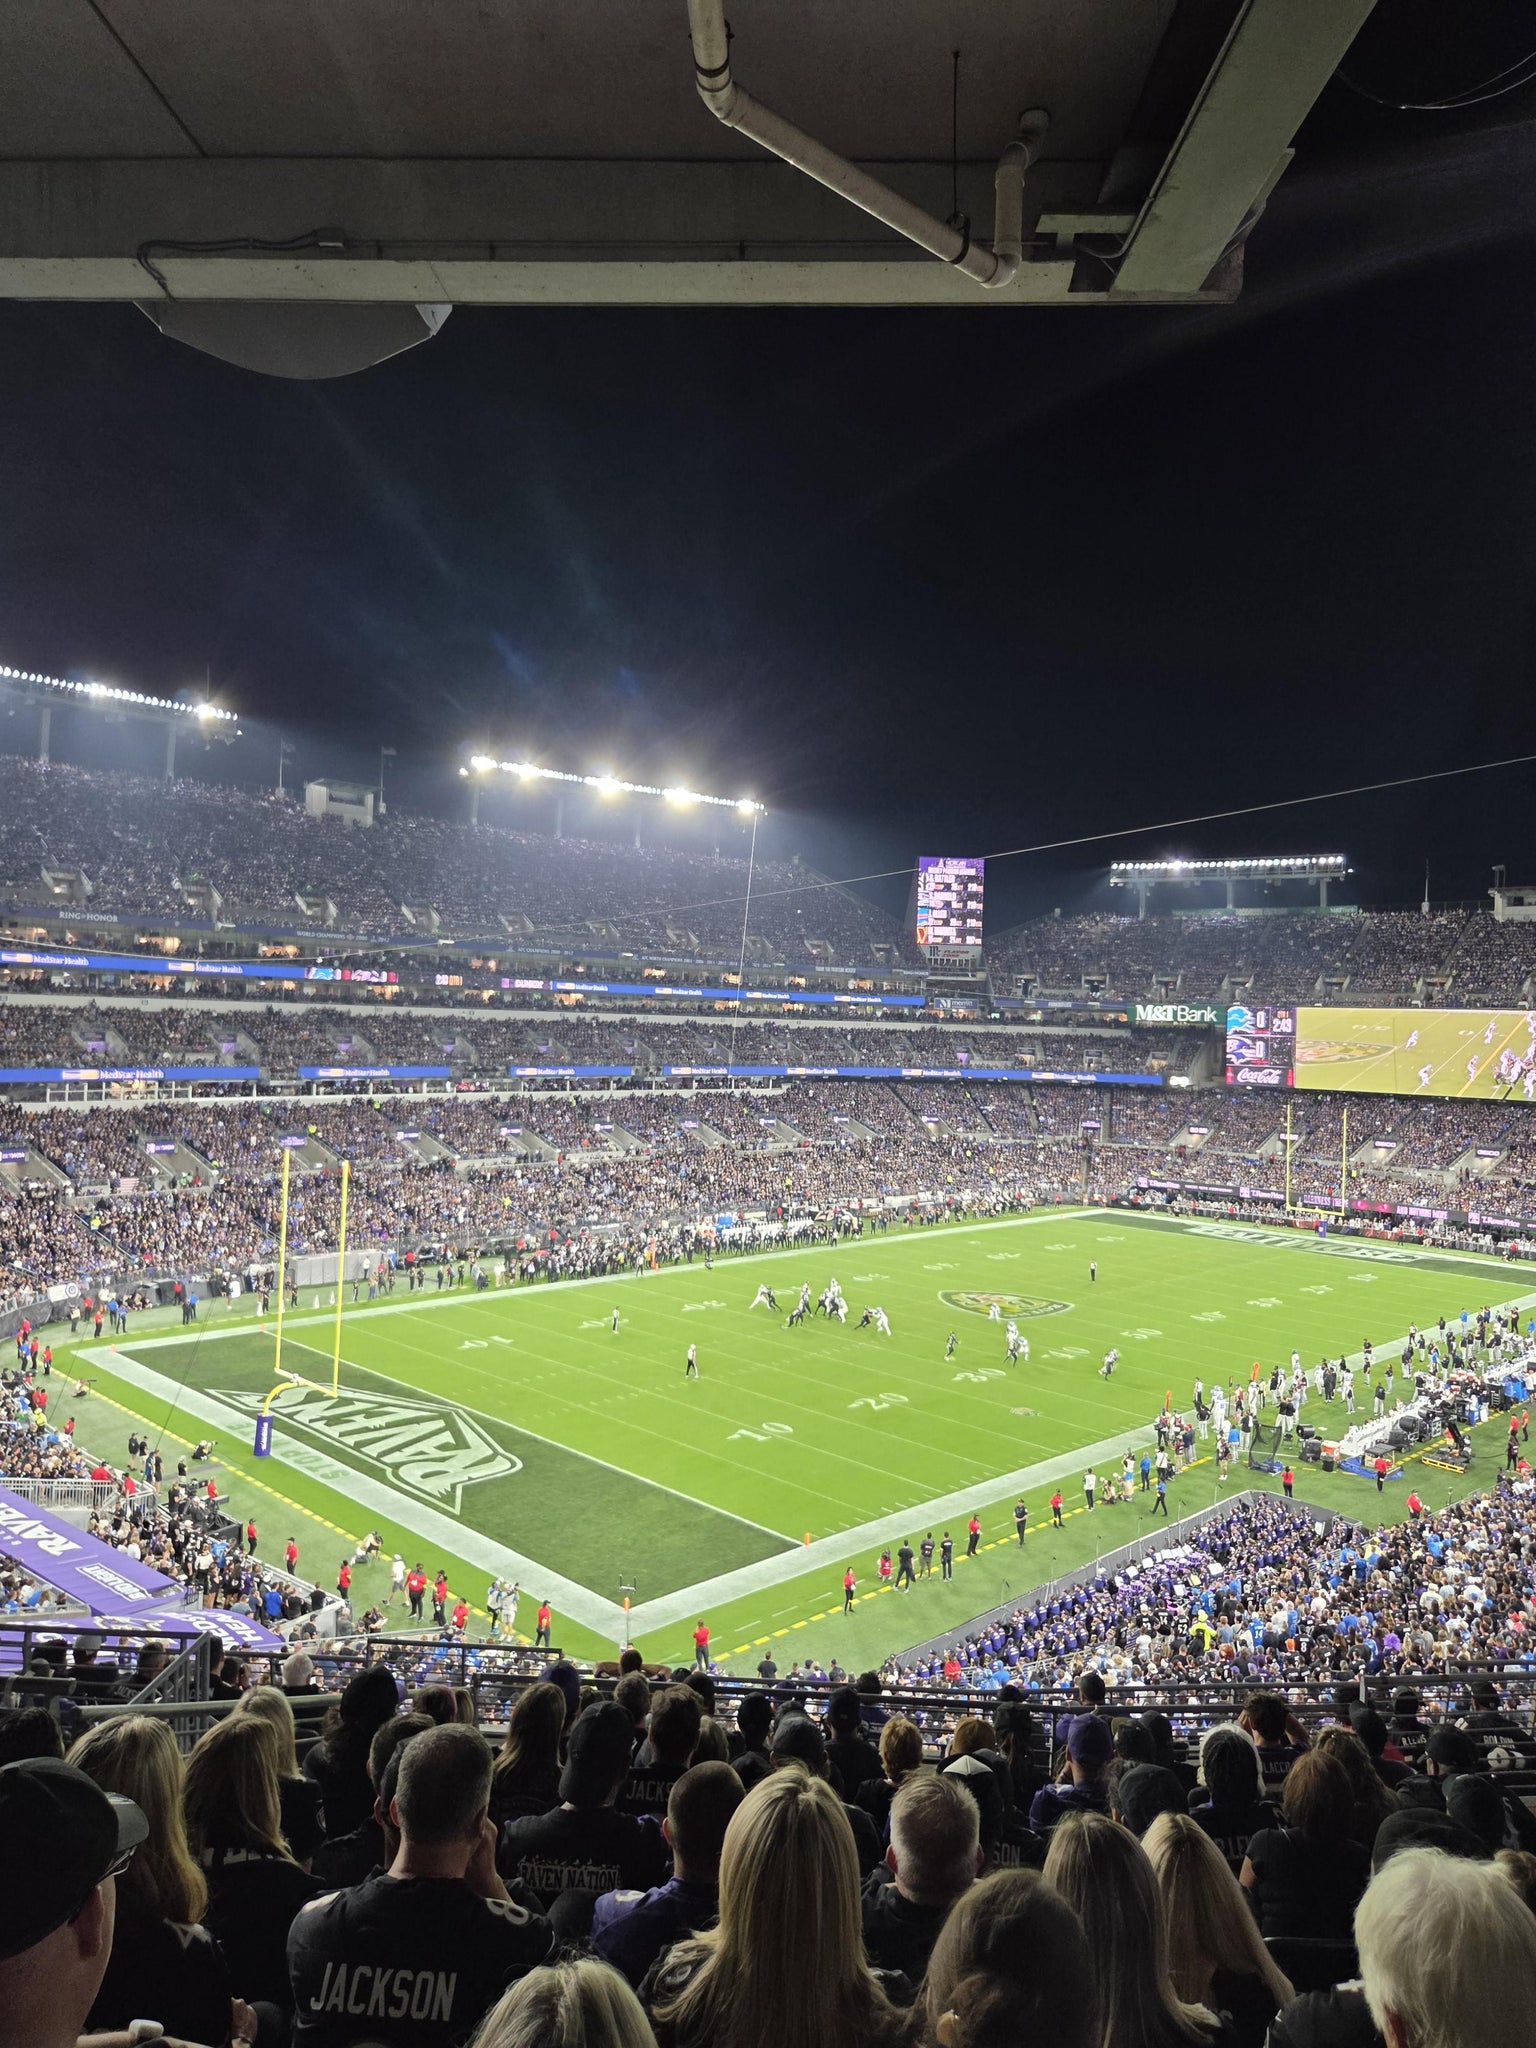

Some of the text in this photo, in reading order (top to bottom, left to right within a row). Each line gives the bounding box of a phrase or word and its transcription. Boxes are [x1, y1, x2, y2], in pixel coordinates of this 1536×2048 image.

[59, 911, 80, 920] RING
[87, 913, 118, 922] HONOR
[33, 956, 89, 966] MedStar Health
[196, 962, 244, 974] MedStar Health
[1136, 1004, 1218, 1022] M&T Bank
[1256, 1011, 1265, 1029] 0
[1273, 1018, 1292, 1033] 2:43
[1256, 1041, 1264, 1058] 0
[100, 1069, 165, 1079] MedStar Health
[711, 1067, 728, 1075] Health
[727, 1421, 794, 1442] 10
[239, 1385, 512, 1498] RAVENS
[520, 1864, 618, 1890] RAVEN NATION
[310, 1961, 457, 2022] JACKSON
